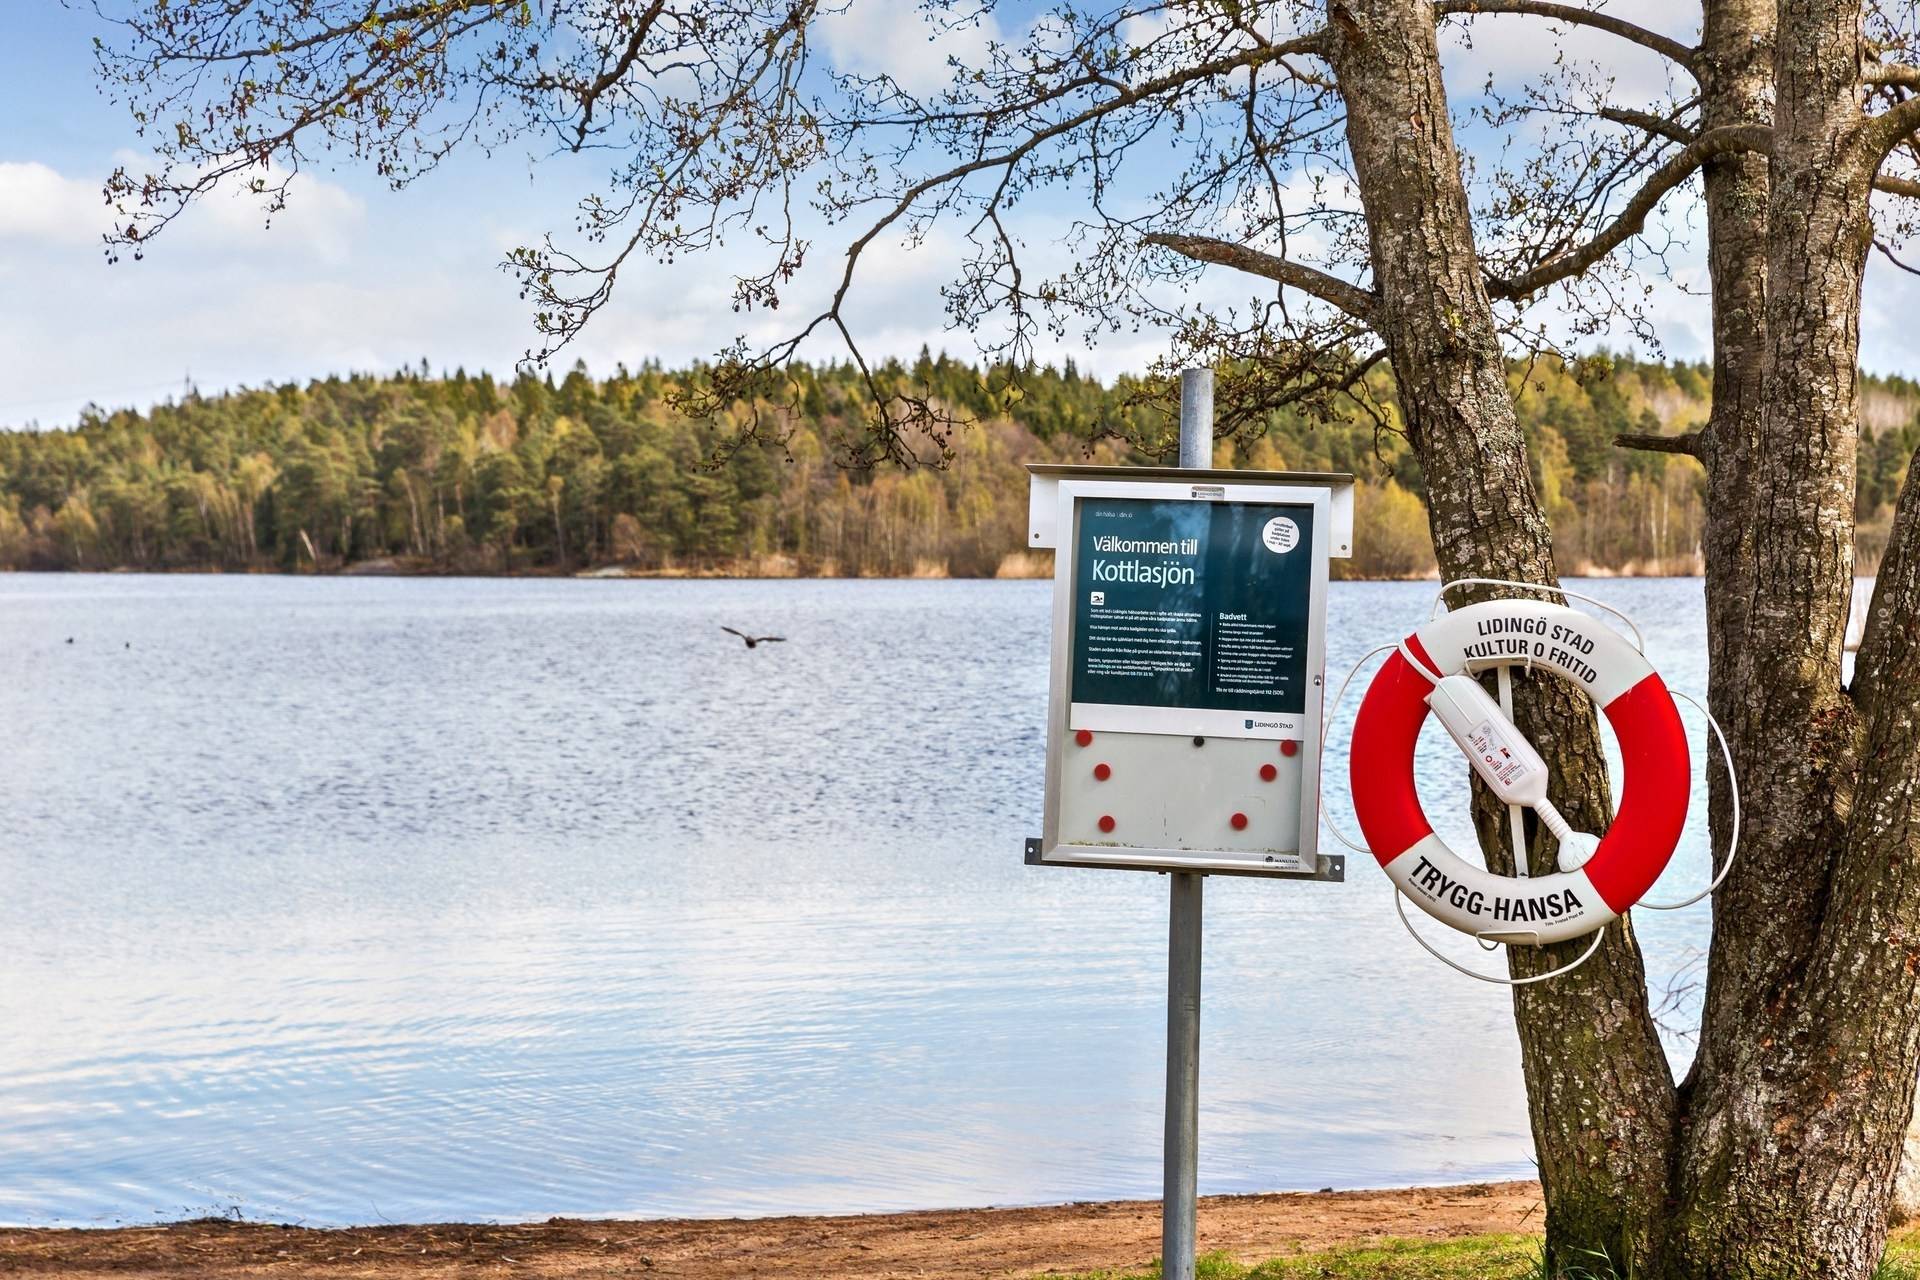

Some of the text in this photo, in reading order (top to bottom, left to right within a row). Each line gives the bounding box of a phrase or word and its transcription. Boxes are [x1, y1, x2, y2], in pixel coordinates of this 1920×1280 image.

[1093, 536, 1198, 555] Välkommen till
[1092, 559, 1194, 588] Kottlasjön
[1219, 612, 1247, 620] Badvett
[1478, 617, 1595, 655] LIDINGÖ STAD
[1464, 639, 1528, 658] KULTUR
[1534, 642, 1544, 657] O
[1549, 647, 1597, 684] FRITID
[1411, 856, 1584, 922] TRYGG-HANSA
